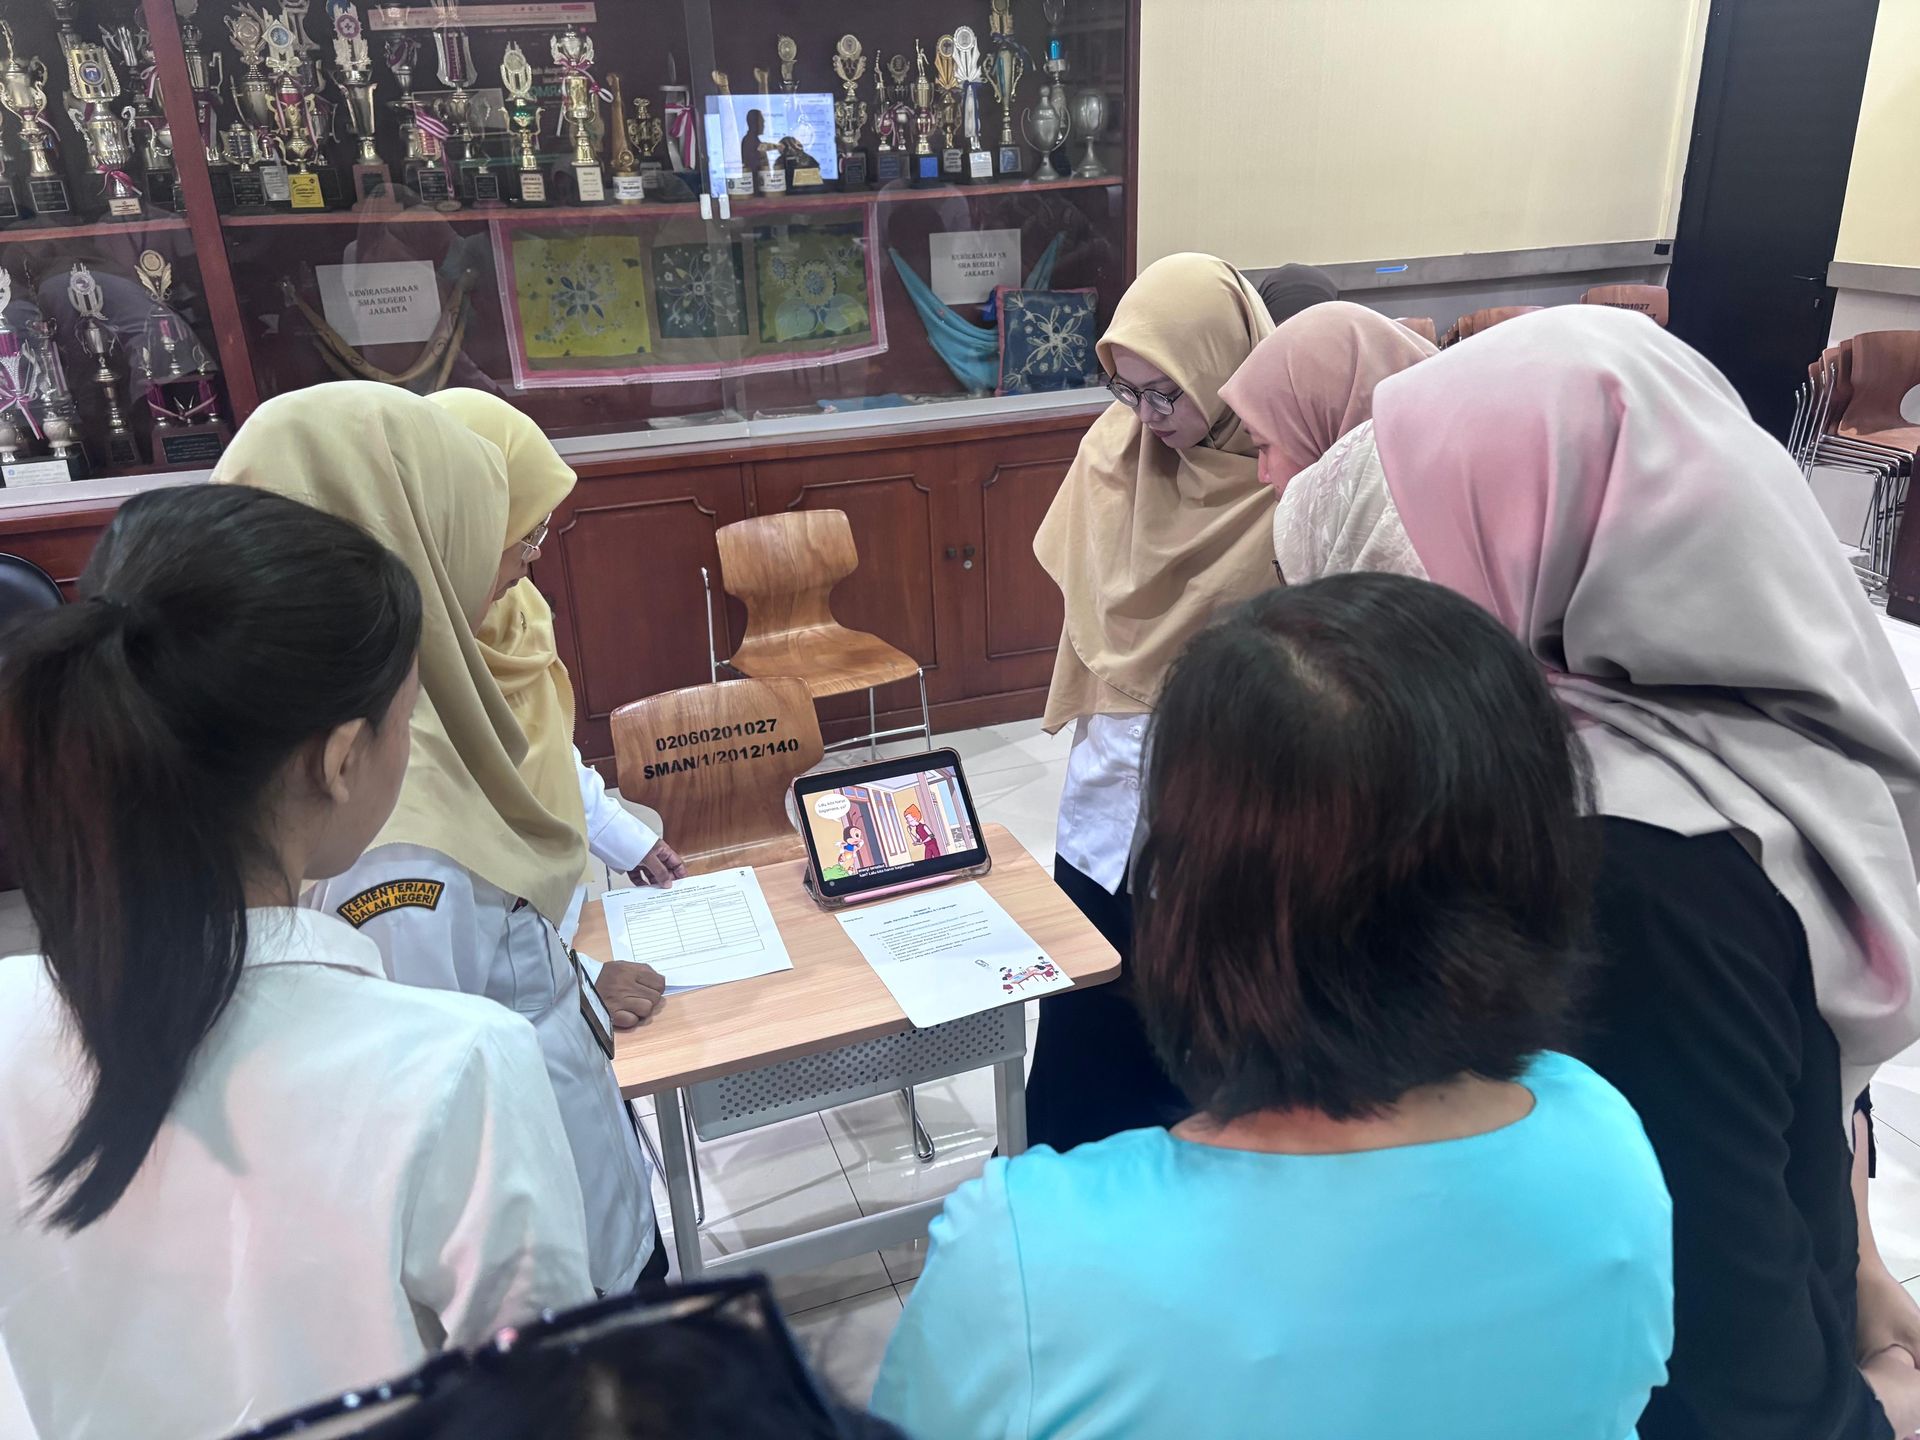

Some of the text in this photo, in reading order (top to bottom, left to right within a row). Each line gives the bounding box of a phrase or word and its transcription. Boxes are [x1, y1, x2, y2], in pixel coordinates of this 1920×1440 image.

[348, 284, 419, 297] KEWIRAUSAHAAN
[358, 299, 376, 307] SMA
[377, 296, 407, 305] NEGERI
[369, 305, 408, 315] JAKARTA
[656, 719, 777, 751] 02060201027
[643, 738, 799, 780] SMAN/1/2012/140
[344, 882, 437, 916] KEMENTERIAN
[352, 893, 434, 922] DALAM NEGERI
